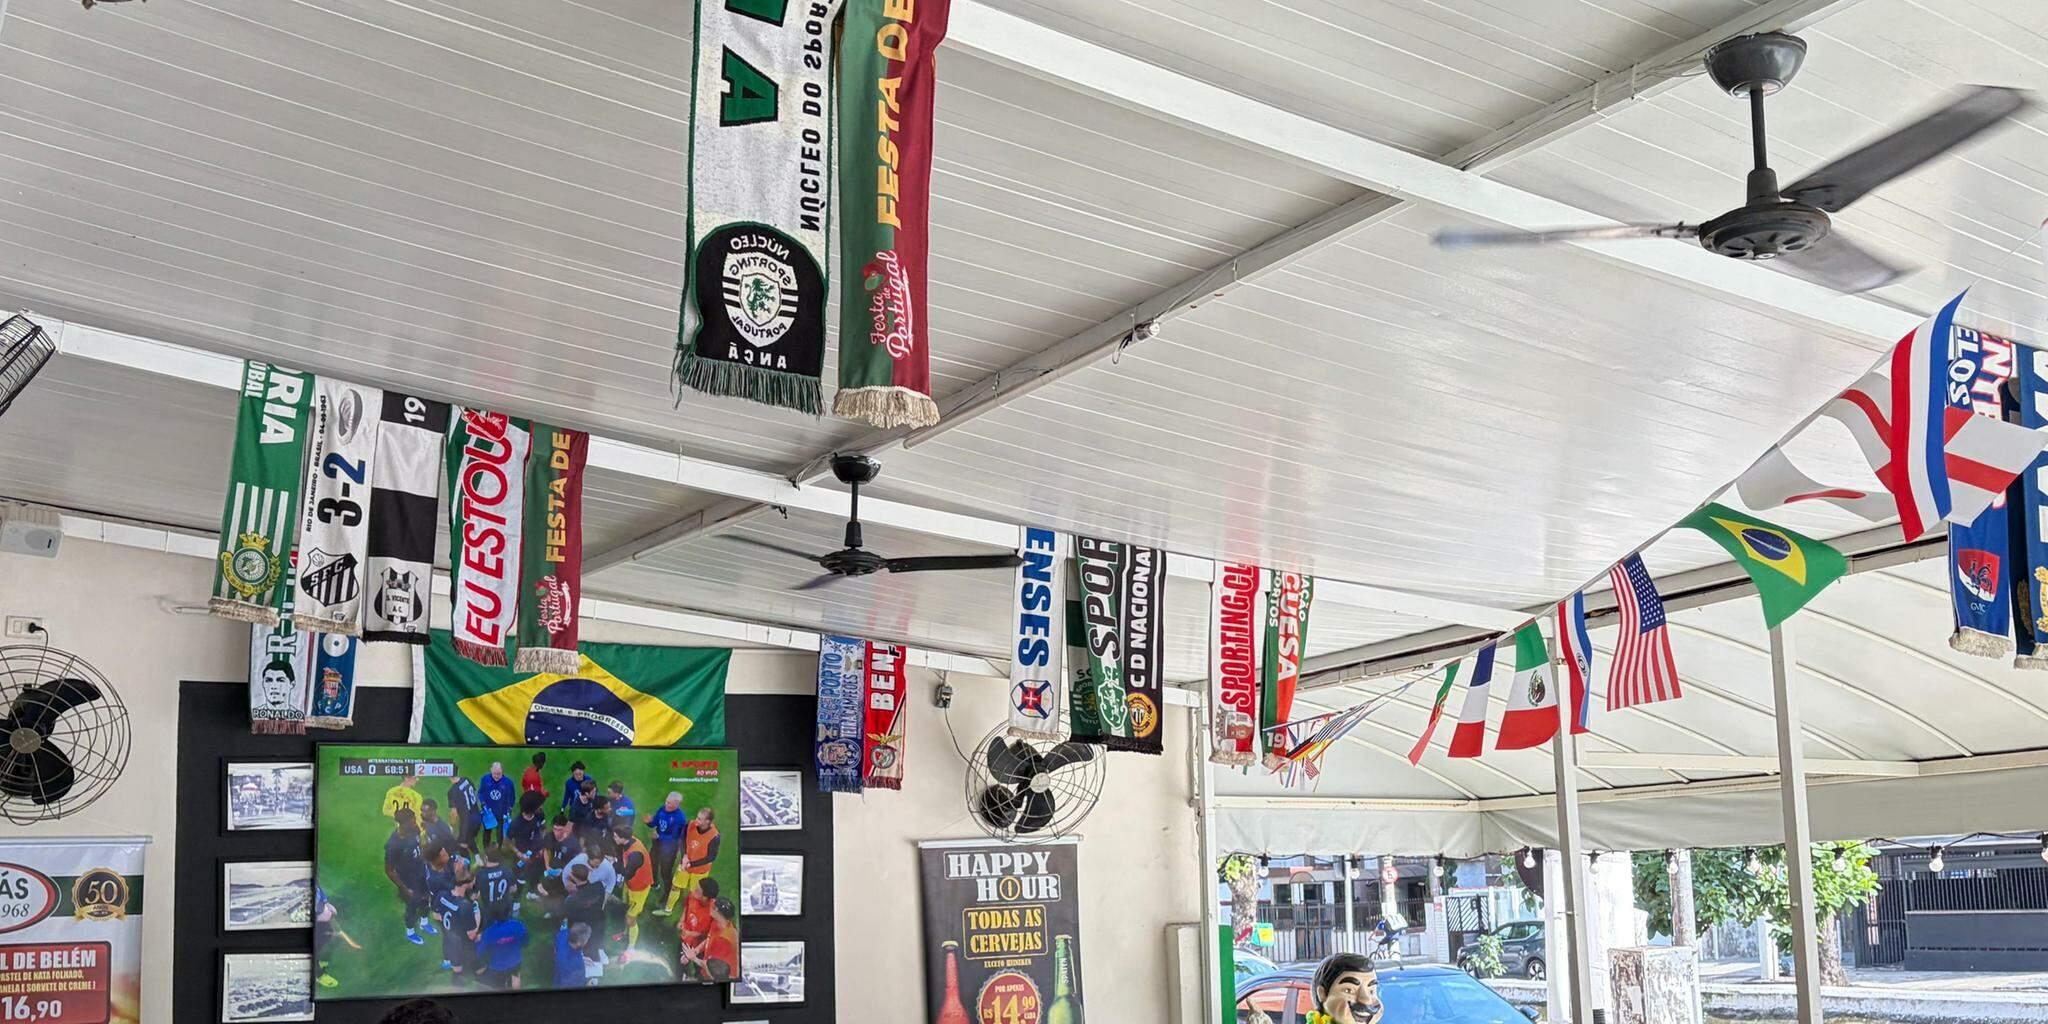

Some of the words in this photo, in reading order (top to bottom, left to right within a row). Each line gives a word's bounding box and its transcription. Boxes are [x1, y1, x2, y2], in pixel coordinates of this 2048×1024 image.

[877, 76, 902, 231] FESTA
[876, 249, 911, 359] Portugal
[869, 292, 886, 345] Festa
[403, 396, 427, 423] 19
[314, 441, 323, 467] BRASIL
[550, 431, 572, 471] DE
[309, 473, 318, 505] JANEIRO
[317, 452, 366, 527] 3-2
[308, 507, 315, 516] DE
[545, 476, 568, 563] FESTA
[544, 575, 564, 634] Portugal
[1018, 527, 1056, 667] ENSES
[1130, 546, 1151, 649] NACIONA
[465, 580, 500, 646] EU
[1220, 594, 1252, 710] SPORTING
[820, 652, 843, 698] PORTO
[252, 708, 305, 720] RONALDO
[1267, 732, 1286, 748] 19
[344, 765, 363, 774] USA
[368, 764, 377, 775] 0
[384, 765, 409, 774] 68:51
[418, 765, 425, 775] 2
[431, 765, 448, 774] POR
[947, 851, 1051, 878] HAPPY
[85, 880, 118, 904] 50
[968, 909, 1020, 930] TODAS
[1024, 908, 1042, 927] AS
[970, 931, 1042, 953] CERVEJAS
[13, 951, 36, 970] DE
[40, 946, 96, 969] BELÉM
[23, 971, 32, 981] DE
[33, 970, 51, 980] NATA
[26, 981, 57, 992] SORVETE
[58, 981, 67, 991] DE
[1, 995, 62, 1022] 16,90
